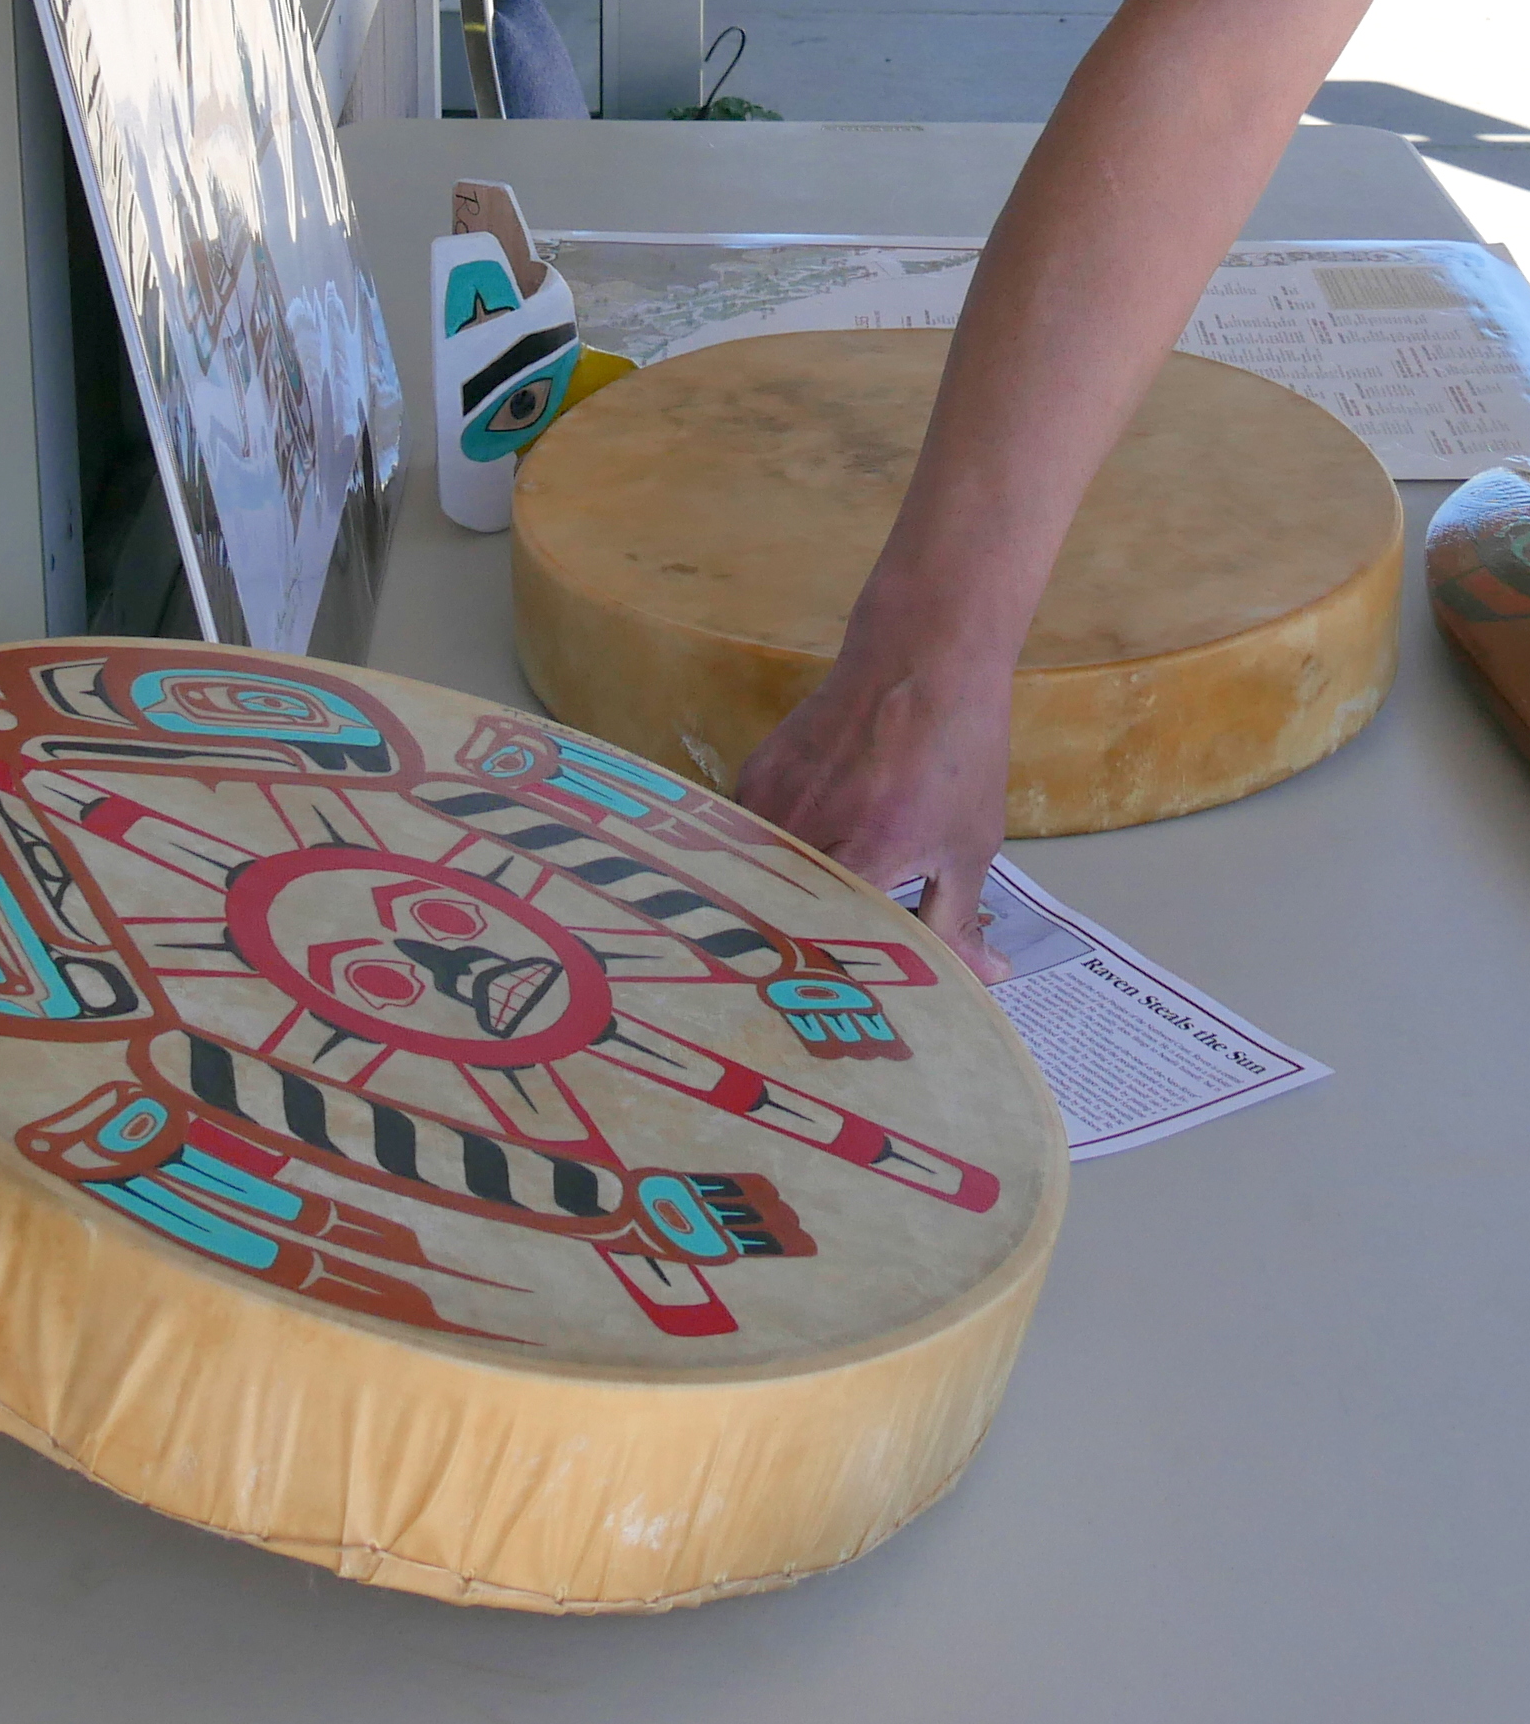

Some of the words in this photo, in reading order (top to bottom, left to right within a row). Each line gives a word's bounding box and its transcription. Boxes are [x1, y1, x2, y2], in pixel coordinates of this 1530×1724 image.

[1079, 957, 1139, 997] Raven
[1137, 996, 1193, 1029] Steals
[1193, 1031, 1227, 1051] the
[1225, 1054, 1266, 1076] Sun
